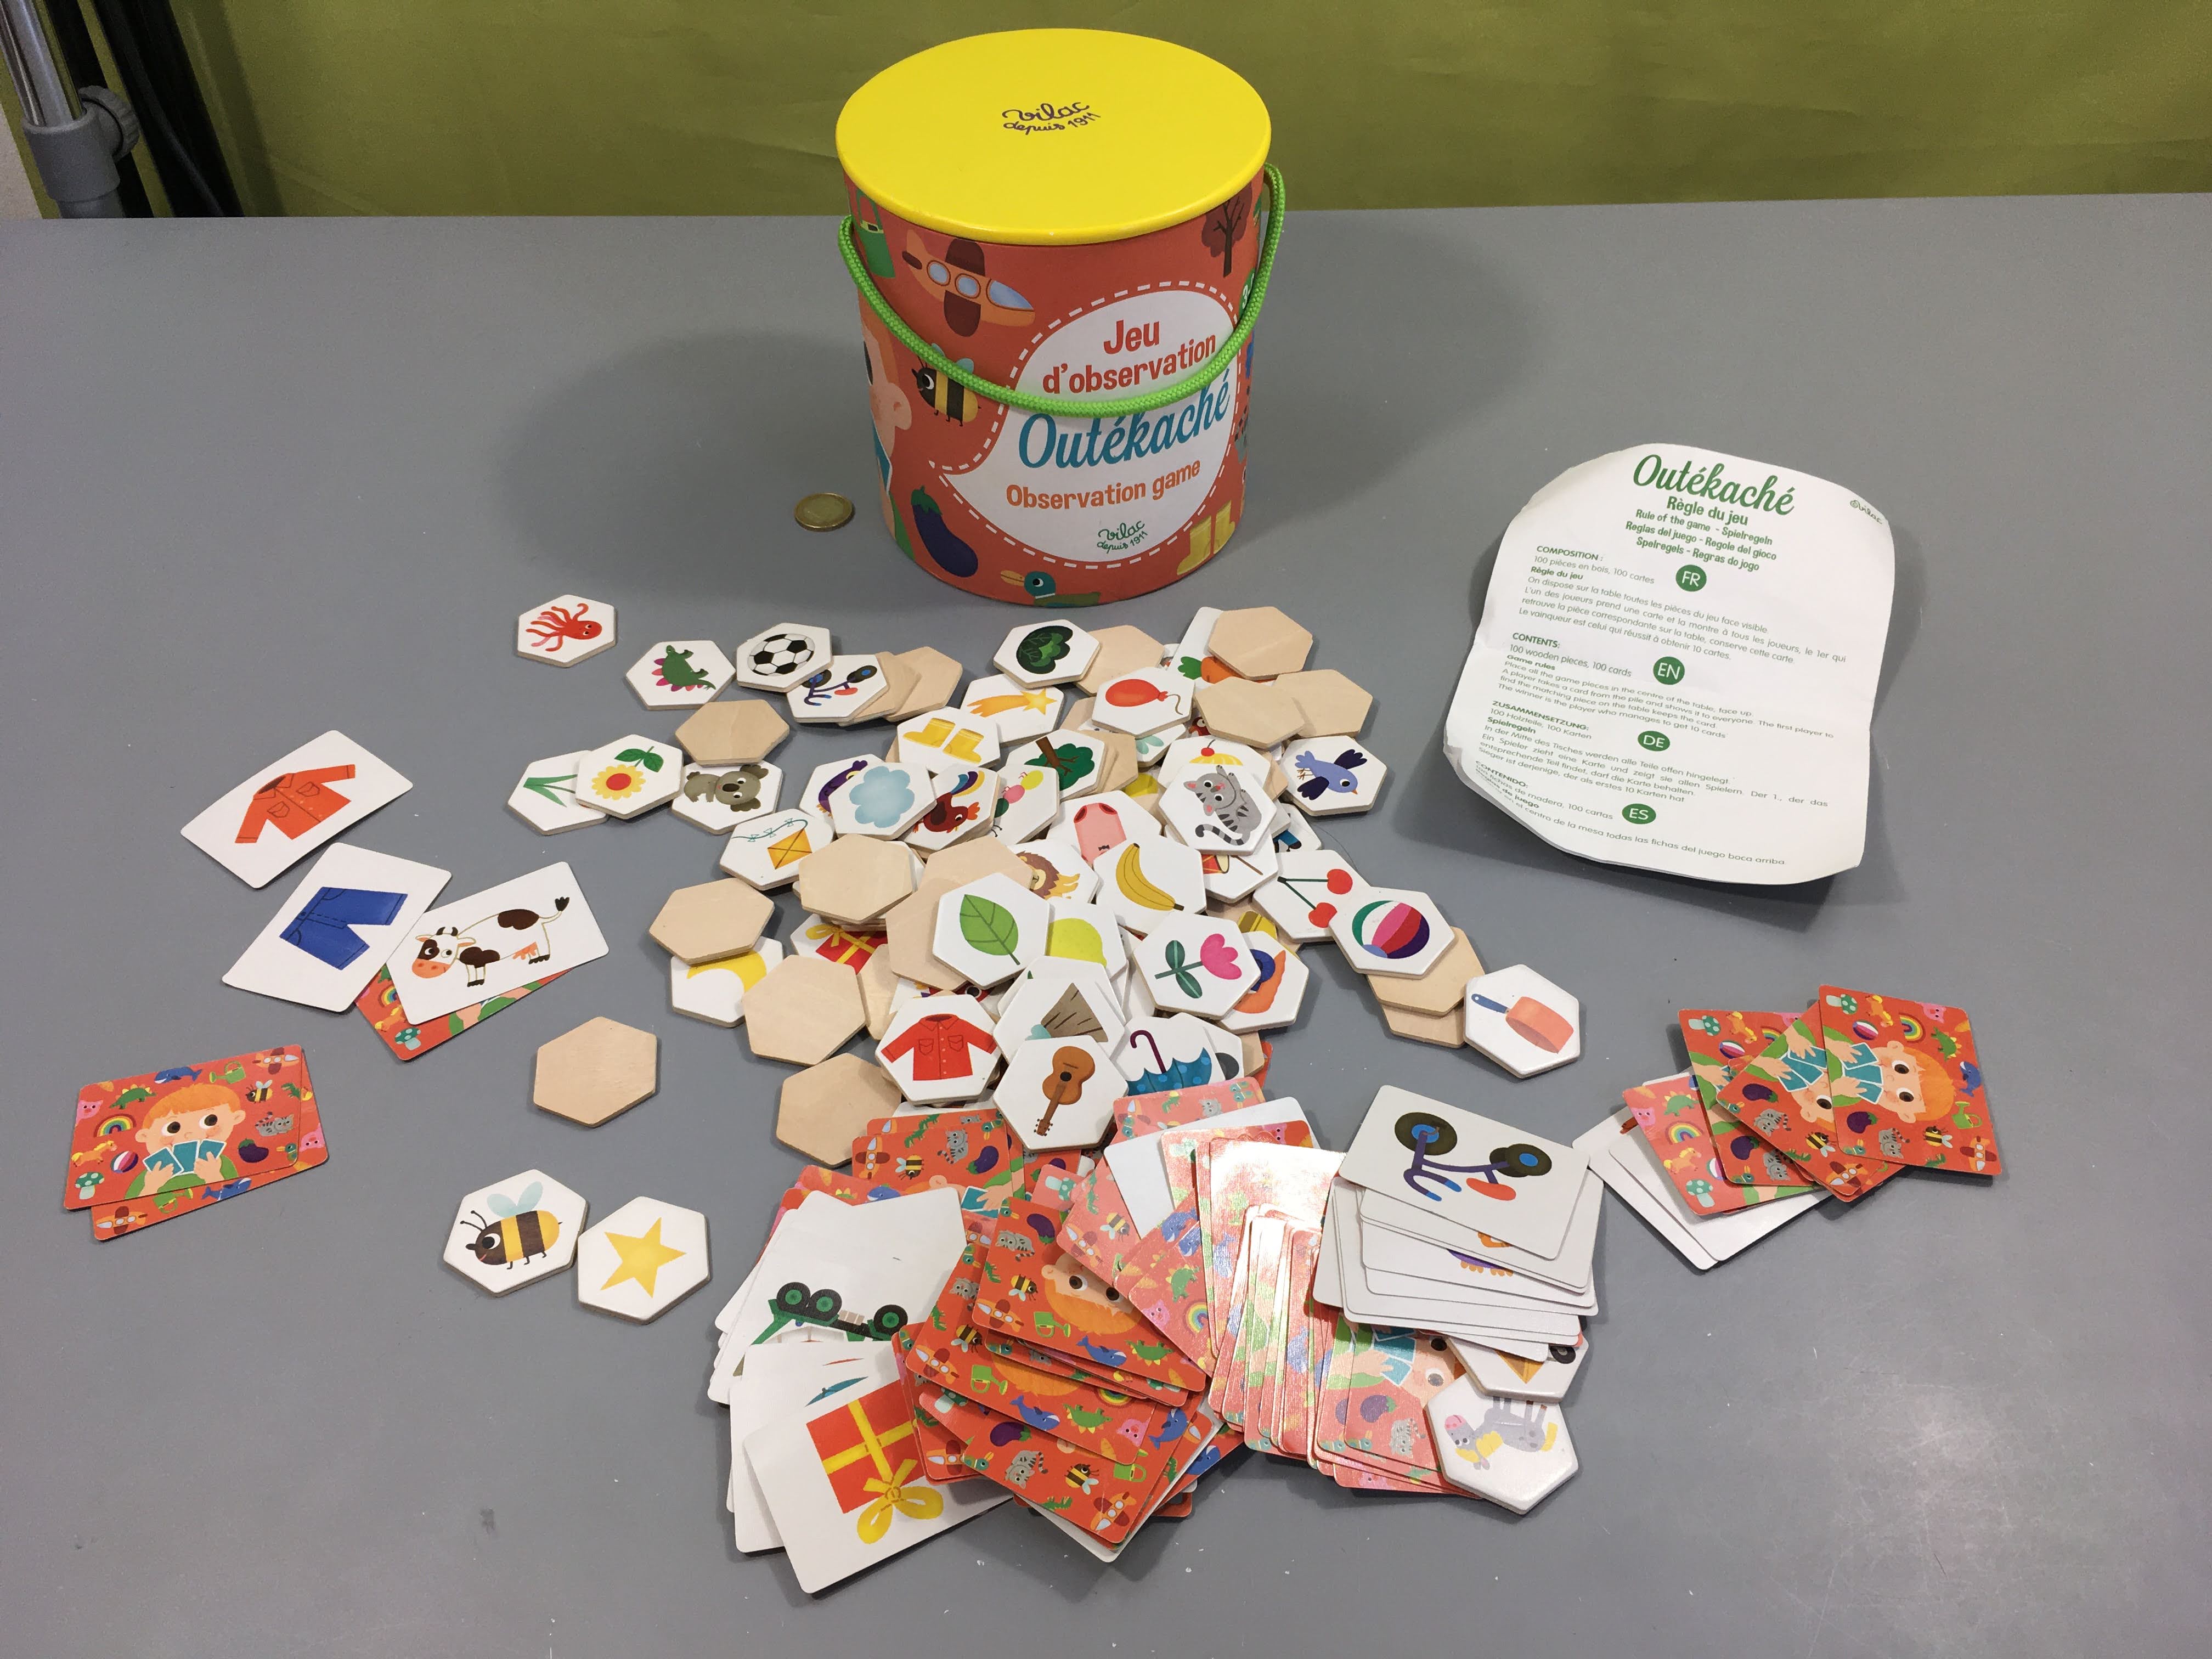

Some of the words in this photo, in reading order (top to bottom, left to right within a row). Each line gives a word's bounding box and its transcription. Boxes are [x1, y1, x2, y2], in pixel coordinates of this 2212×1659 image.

[1003, 121, 1066, 136] depuis
[1067, 112, 1102, 128] 1911
[1103, 320, 1161, 356] Jeu
[1042, 334, 1217, 394] d'observation
[1018, 368, 1231, 469] Outékaché
[1006, 482, 1146, 510] Observation
[1152, 460, 1201, 500] game
[1633, 454, 1796, 516] Outékaché
[1635, 509, 1655, 520] Rule
[1656, 513, 1668, 522] of
[1669, 515, 1685, 525] the
[1686, 521, 1711, 532] game
[1721, 526, 1773, 545] Spielregeln
[1666, 495, 1704, 516] Règle
[1707, 506, 1725, 521] du
[1724, 510, 1748, 526] jeu
[1097, 540, 1129, 554] depuis
[1130, 530, 1148, 546] 1911
[1536, 545, 1599, 561] COMPOSITION
[1625, 520, 1655, 534] Reglas
[1657, 527, 1672, 537] del
[1671, 529, 1697, 544] juego
[1705, 536, 1735, 551] Regole
[1736, 544, 1751, 554] del
[1752, 548, 1776, 560] gioco
[1636, 536, 1684, 554] Spelregels
[1692, 548, 1725, 563] Regras
[1727, 556, 1739, 566] do
[1737, 558, 1759, 572] jogo
[1530, 566, 1554, 575] Règle
[1569, 572, 1583, 580] jeu
[1534, 555, 1548, 564] 100
[1549, 558, 1576, 568] pièces
[1590, 563, 1610, 574] bois,
[1613, 567, 1628, 577] 100
[1629, 573, 1655, 584] cartes
[1681, 571, 1701, 587] FR
[1527, 575, 1540, 584] On
[1541, 578, 1574, 589] dispose
[1590, 585, 1599, 594] la
[1600, 588, 1622, 599] table
[1623, 593, 1649, 606] toutes
[1650, 599, 1662, 609] les
[1663, 604, 1691, 616] pièces
[1692, 610, 1705, 619] du
[1705, 613, 1719, 622] jeu
[1721, 616, 1740, 627] face
[1512, 632, 1560, 648] CONTENTS:
[1519, 607, 1528, 615] Le
[1530, 610, 1572, 623] vainqueur
[1587, 622, 1607, 630] celui
[1608, 626, 1622, 634] qui
[1623, 629, 1651, 641] réussit
[1660, 637, 1690, 650] obtenir
[1692, 645, 1702, 653] 10
[1703, 648, 1731, 659] cartes.
[1521, 597, 1555, 608] retrouve
[1557, 602, 1565, 610] la
[1566, 606, 1590, 615] pièce
[1591, 611, 1657, 630] correspondante
[1673, 628, 1682, 636] la
[1684, 631, 1706, 644] table,
[1709, 639, 1747, 652] conserve
[1749, 648, 1770, 658] cette
[1524, 586, 1541, 595] L'un
[1544, 589, 1559, 598] des
[1561, 592, 1593, 604] joueurs
[1595, 600, 1621, 610] prend
[1623, 606, 1640, 614] une
[1642, 611, 1664, 620] carte
[1677, 617, 1686, 626] la
[1688, 622, 1719, 634] montre
[1731, 630, 1750, 640] tous
[1752, 635, 1764, 645] les
[1767, 639, 1801, 654] joueurs,
[1804, 647, 1813, 655] le
[1816, 650, 1829, 658] 1er
[1831, 654, 1846, 663] qui
[1506, 654, 1533, 665] Game
[1534, 662, 1555, 670] rules
[1510, 644, 1523, 653] 100
[1525, 648, 1559, 661] wooden
[1560, 655, 1589, 668] pieces,
[1592, 661, 1607, 671] 100
[1607, 666, 1632, 677] cards
[1657, 662, 1680, 680] EN
[1504, 661, 1526, 671] Place
[1555, 675, 1580, 685] game
[1581, 680, 1609, 690] pieces
[1637, 690, 1664, 699] centre
[1692, 702, 1716, 712] table,
[1487, 716, 1536, 734] Spielregeln
[1490, 708, 1505, 716] 100
[1506, 712, 1543, 728] Holzteile,
[1547, 724, 1561, 732] 100
[1562, 729, 1592, 739] Karten
[1492, 700, 1589, 731] ZUSAMMENSETZUNG:
[1510, 731, 1532, 742] Mitte
[1534, 738, 1550, 747] des
[1553, 742, 1583, 755] Tisches
[1585, 752, 1619, 762] werden
[1640, 760, 1658, 770] Teile
[1661, 766, 1684, 775] offen
[1643, 735, 1666, 748] DE
[1481, 733, 1494, 741] Ein
[1499, 737, 1528, 750] Spieler
[1532, 747, 1554, 756] zieht
[1558, 754, 1577, 763] eine
[1581, 759, 1605, 769] Karte
[1610, 765, 1628, 774] und
[1633, 770, 1655, 780] zeigt
[1678, 779, 1700, 788] allen
[1751, 790, 1768, 798] Der
[1527, 793, 1564, 808] madera,
[1568, 803, 1583, 812] 100
[1585, 809, 1613, 820] cartas
[1629, 808, 1649, 820] ES
[1578, 825, 1604, 836] mesa
[1606, 832, 1632, 841] todas
[1651, 838, 1679, 849] fichas
[1698, 848, 1725, 858] juego
[1728, 853, 1752, 862] boca
